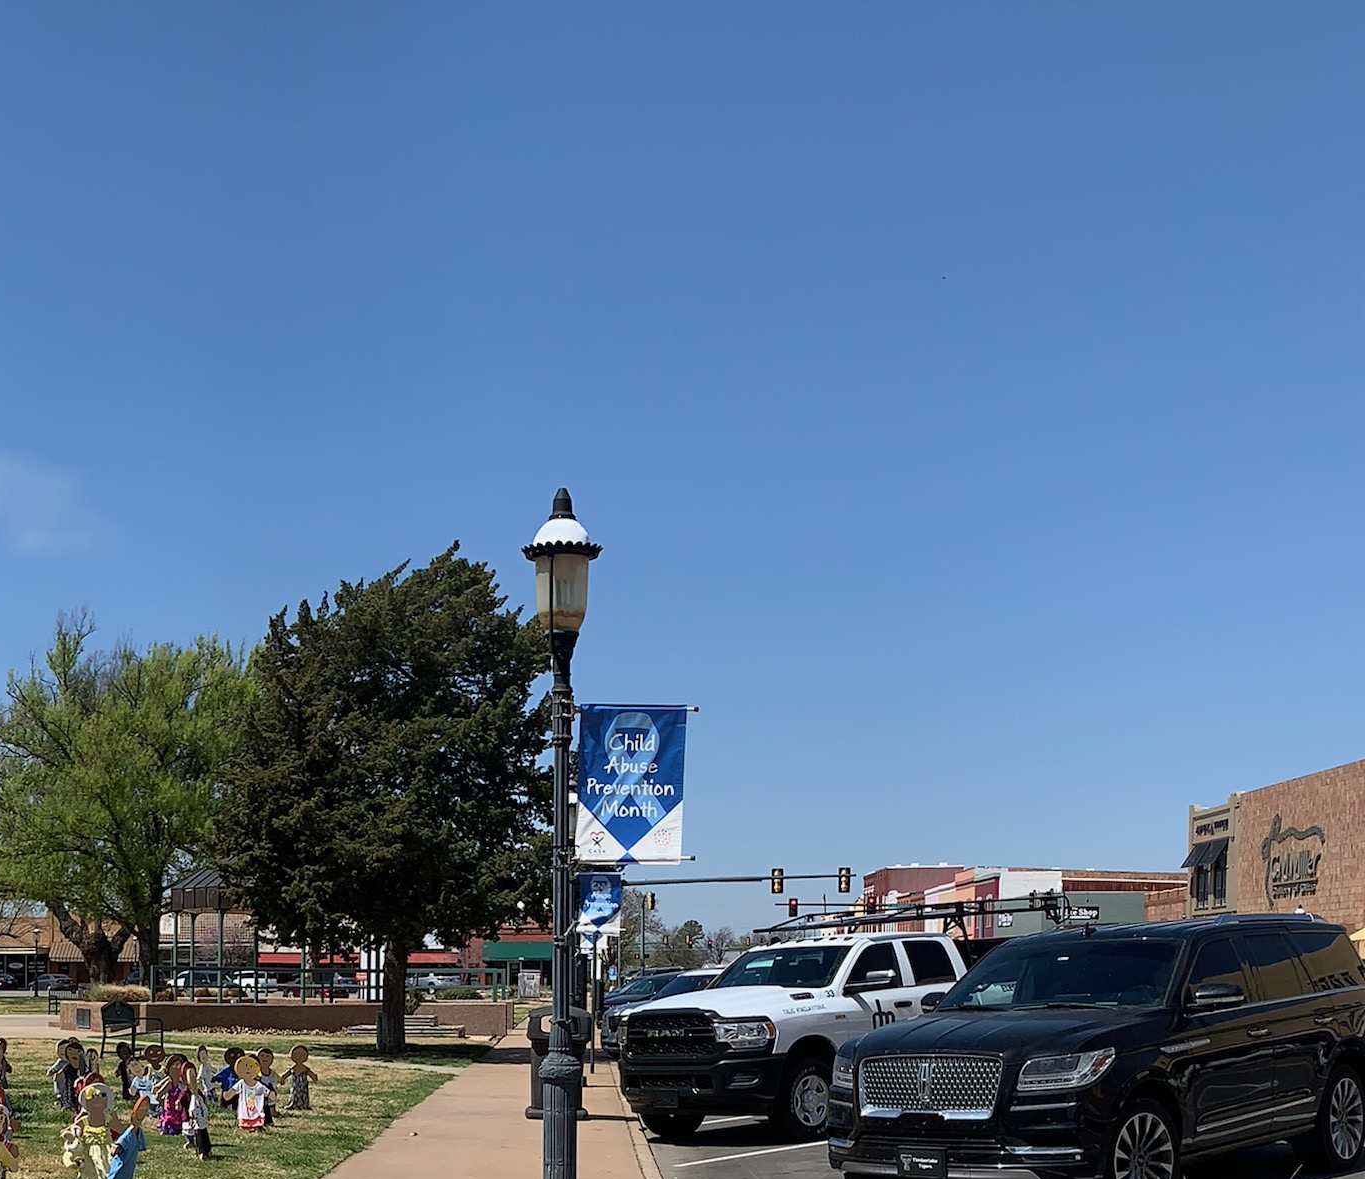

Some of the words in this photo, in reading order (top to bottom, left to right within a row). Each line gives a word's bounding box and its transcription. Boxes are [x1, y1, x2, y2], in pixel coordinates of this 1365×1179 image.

[609, 733, 655, 752] Child
[603, 758, 658, 774] Abuse
[586, 778, 674, 796] Prevention
[601, 800, 657, 818] Month
[1078, 908, 1098, 918] Shop
[825, 990, 835, 998] 33
[647, 1029, 685, 1037] RAM
